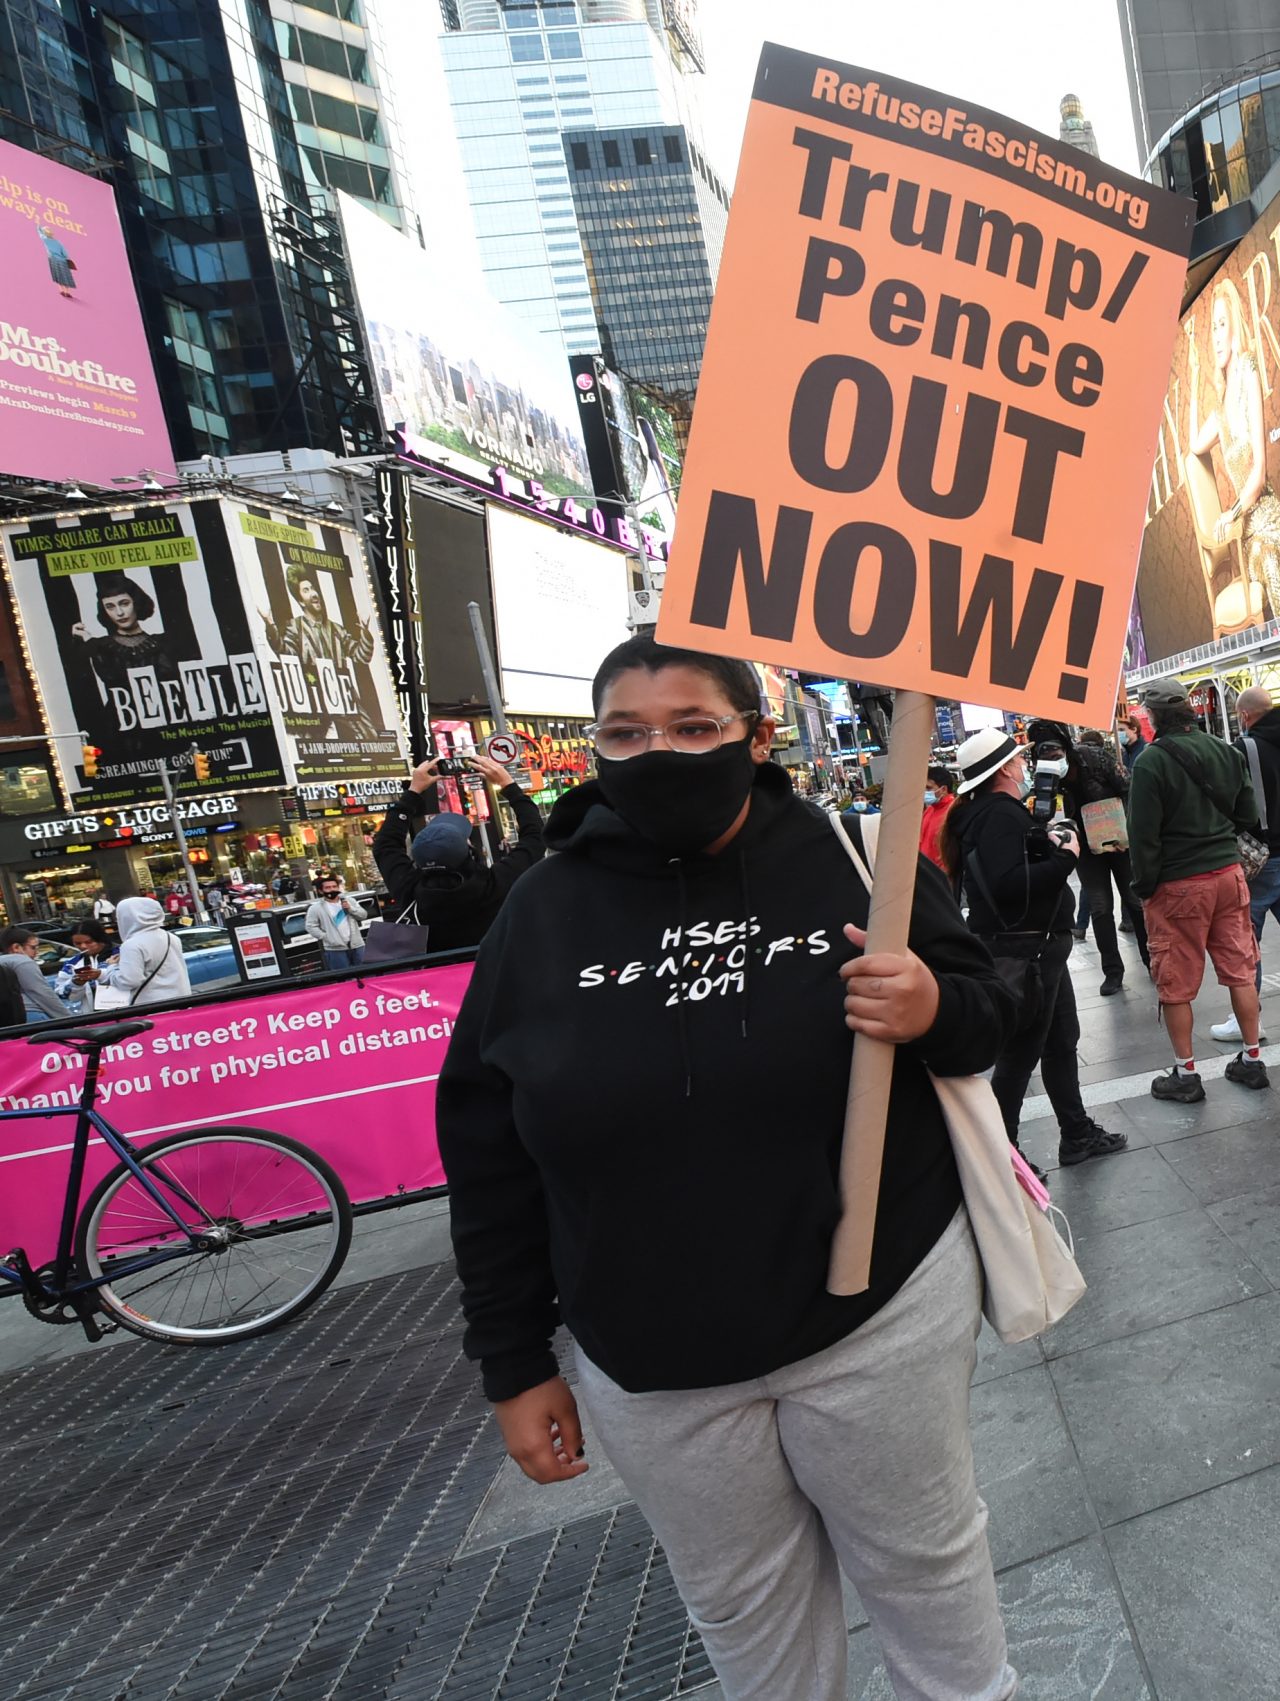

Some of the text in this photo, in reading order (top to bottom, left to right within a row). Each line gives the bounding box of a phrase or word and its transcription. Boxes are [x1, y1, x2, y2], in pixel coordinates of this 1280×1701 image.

[811, 66, 1150, 230] RefuseFascism.org
[27, 186, 42, 204] is
[46, 198, 70, 214] on
[43, 209, 87, 236] dear.
[790, 126, 1150, 324] Trump/
[0, 320, 66, 352] Mrs.
[796, 236, 1104, 407] Pence
[0, 379, 55, 401] Previews
[56, 393, 90, 409] begin
[93, 402, 128, 418] March
[129, 411, 137, 420] 9
[580, 393, 596, 404] LG
[461, 425, 544, 475] VORNADO
[788, 353, 1086, 545] OUT
[183, 471, 233, 480] LAMAR
[480, 450, 535, 479] REALTY TRUST
[15, 517, 177, 554] TIMES SQUARE CAN REALLY
[247, 518, 310, 546] RAISING SPIRITS
[51, 541, 193, 572] MAKE YOU FEEL ALIVE!
[289, 547, 345, 570] ON BROADWAY!
[689, 489, 1105, 704] NOW!
[109, 655, 266, 731] BEETLE
[273, 660, 358, 715] JUICE
[160, 718, 272, 741] The Musical. The Musical
[283, 718, 321, 727] The Musical
[308, 742, 360, 754] JAW-DROPPING
[95, 757, 167, 779] CREAMINGL
[225, 774, 241, 783] 50TH
[247, 770, 280, 779] BROADWAY
[297, 780, 404, 801] GIFTS LUGGAGE
[24, 796, 239, 840] GIFTS LUGGAGE
[368, 803, 388, 812] SONY
[141, 831, 175, 842] SONY
[176, 884, 184, 895] 4
[232, 869, 240, 882] 4
[661, 916, 761, 950] HSES
[665, 971, 745, 1007] 2019
[40, 1051, 84, 1074] On
[151, 1018, 257, 1055] street?
[267, 1009, 342, 1037] Keep
[349, 998, 371, 1020] 6
[375, 987, 440, 1016] feet.
[98, 1077, 152, 1104] you
[160, 1066, 201, 1089] for
[210, 1040, 331, 1084] physical
[338, 1019, 456, 1057] distanci
